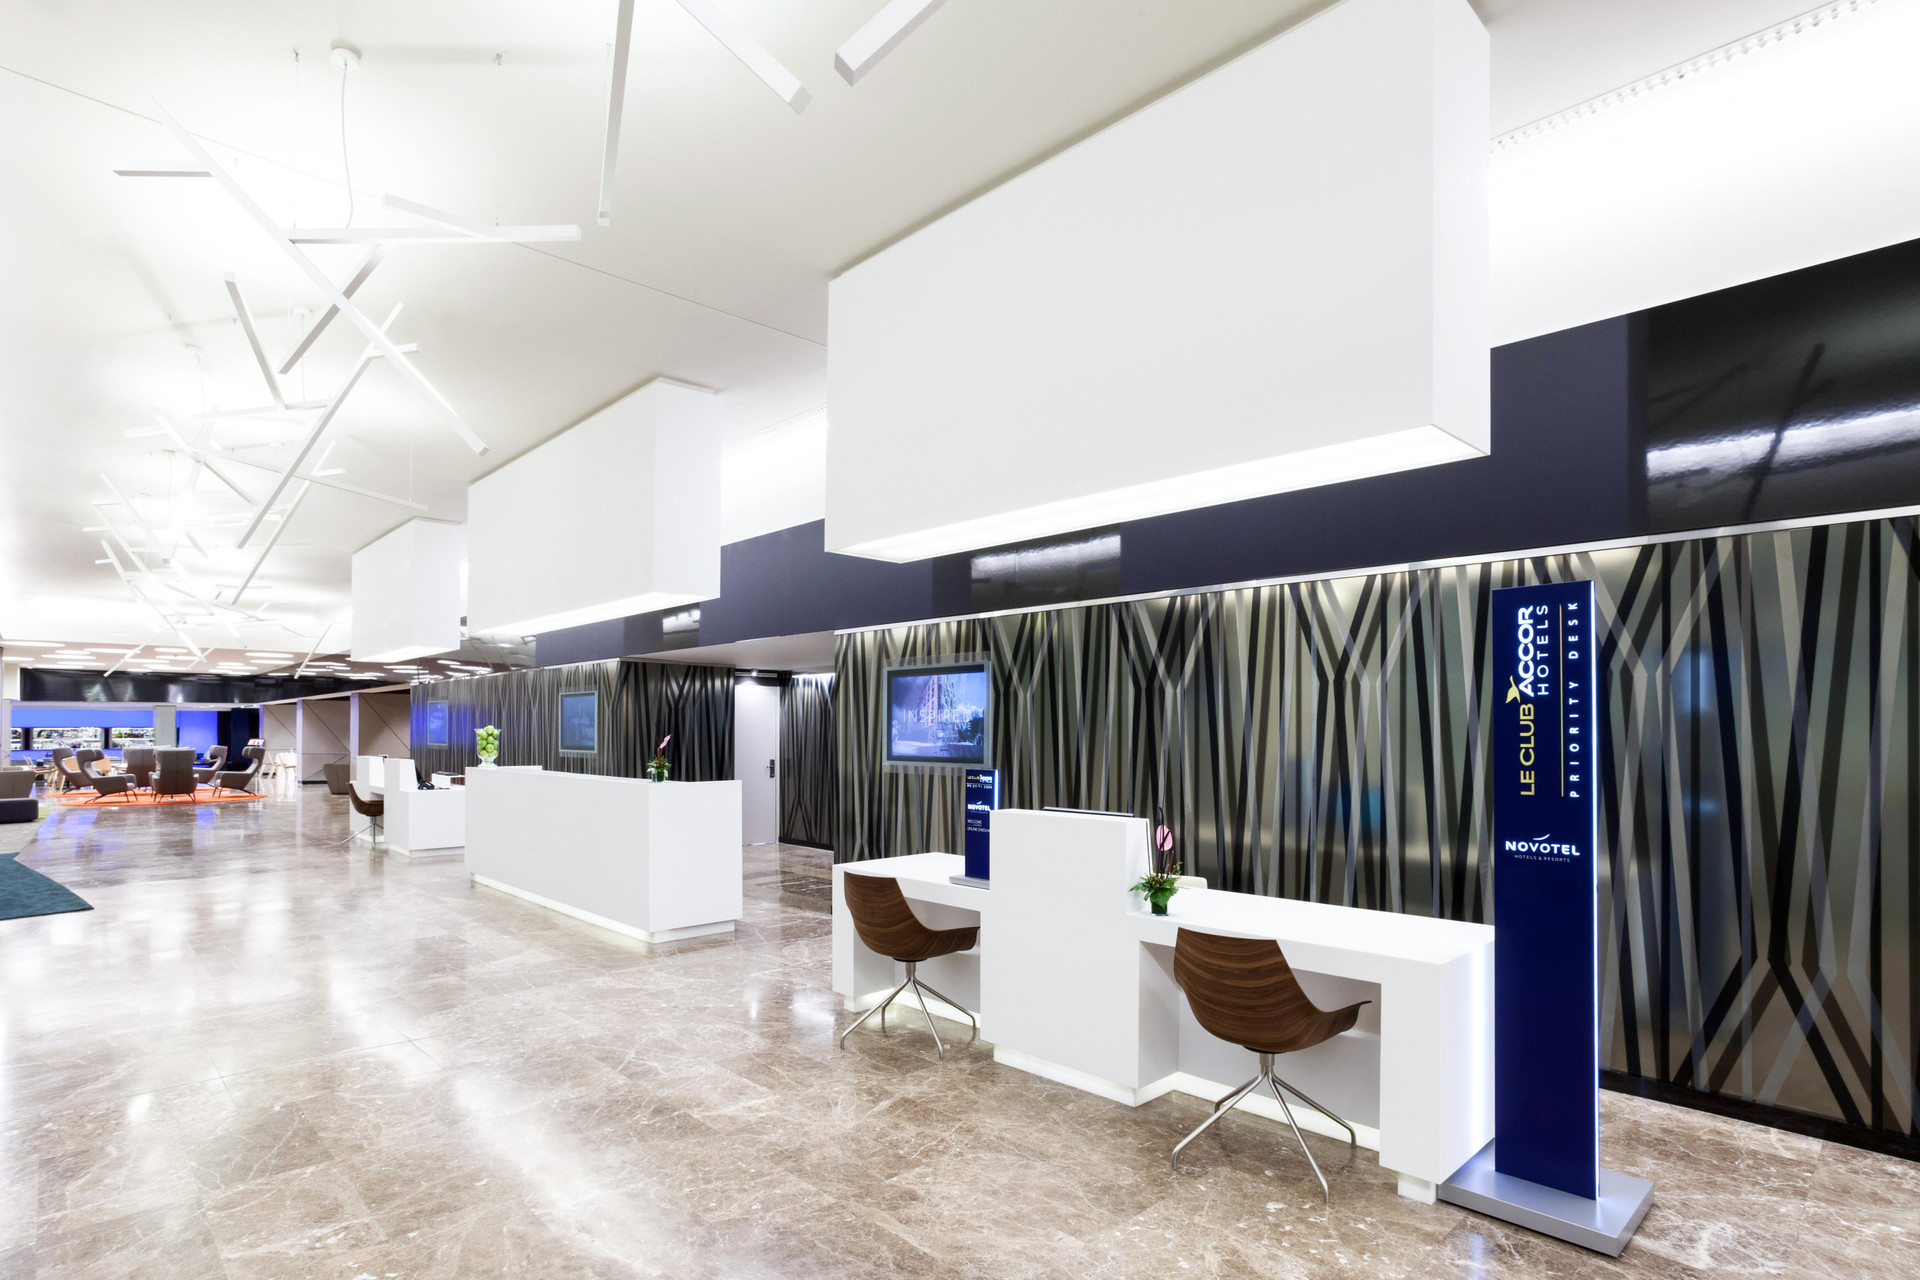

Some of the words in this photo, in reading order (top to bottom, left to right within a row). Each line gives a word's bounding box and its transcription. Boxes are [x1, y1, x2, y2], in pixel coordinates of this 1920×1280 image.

[1518, 605, 1534, 697] ACCOR
[1537, 604, 1549, 695] HOTELS
[1568, 602, 1579, 659] DESK
[1520, 703, 1535, 766] CLUB
[1569, 681, 1580, 797] PRIORITY
[1520, 770, 1536, 795] LE
[1505, 840, 1580, 856] NOVOTEL
